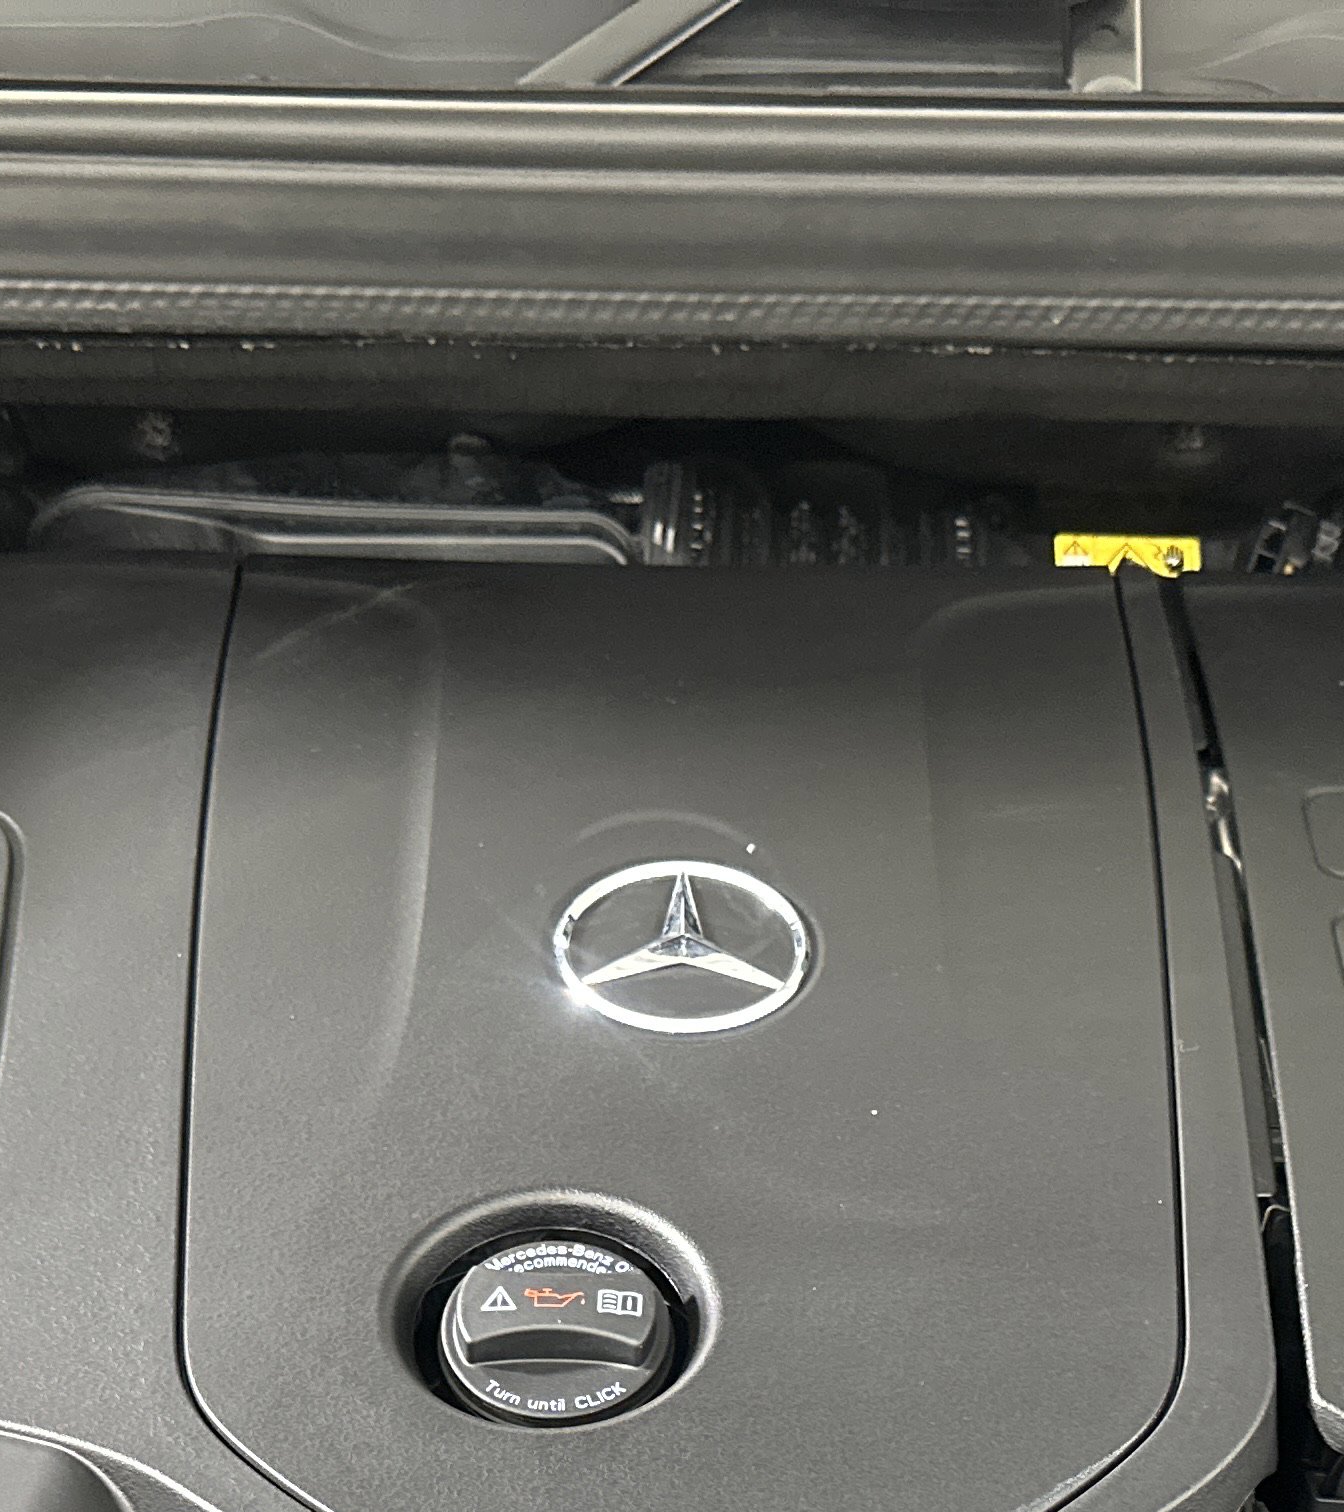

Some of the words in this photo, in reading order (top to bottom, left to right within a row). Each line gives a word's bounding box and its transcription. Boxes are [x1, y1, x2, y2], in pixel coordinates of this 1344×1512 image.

[484, 1244, 614, 1271] Mercedes-Benz
[485, 1379, 521, 1406] Turn
[527, 1398, 566, 1411] until
[574, 1381, 627, 1409] CLICK
